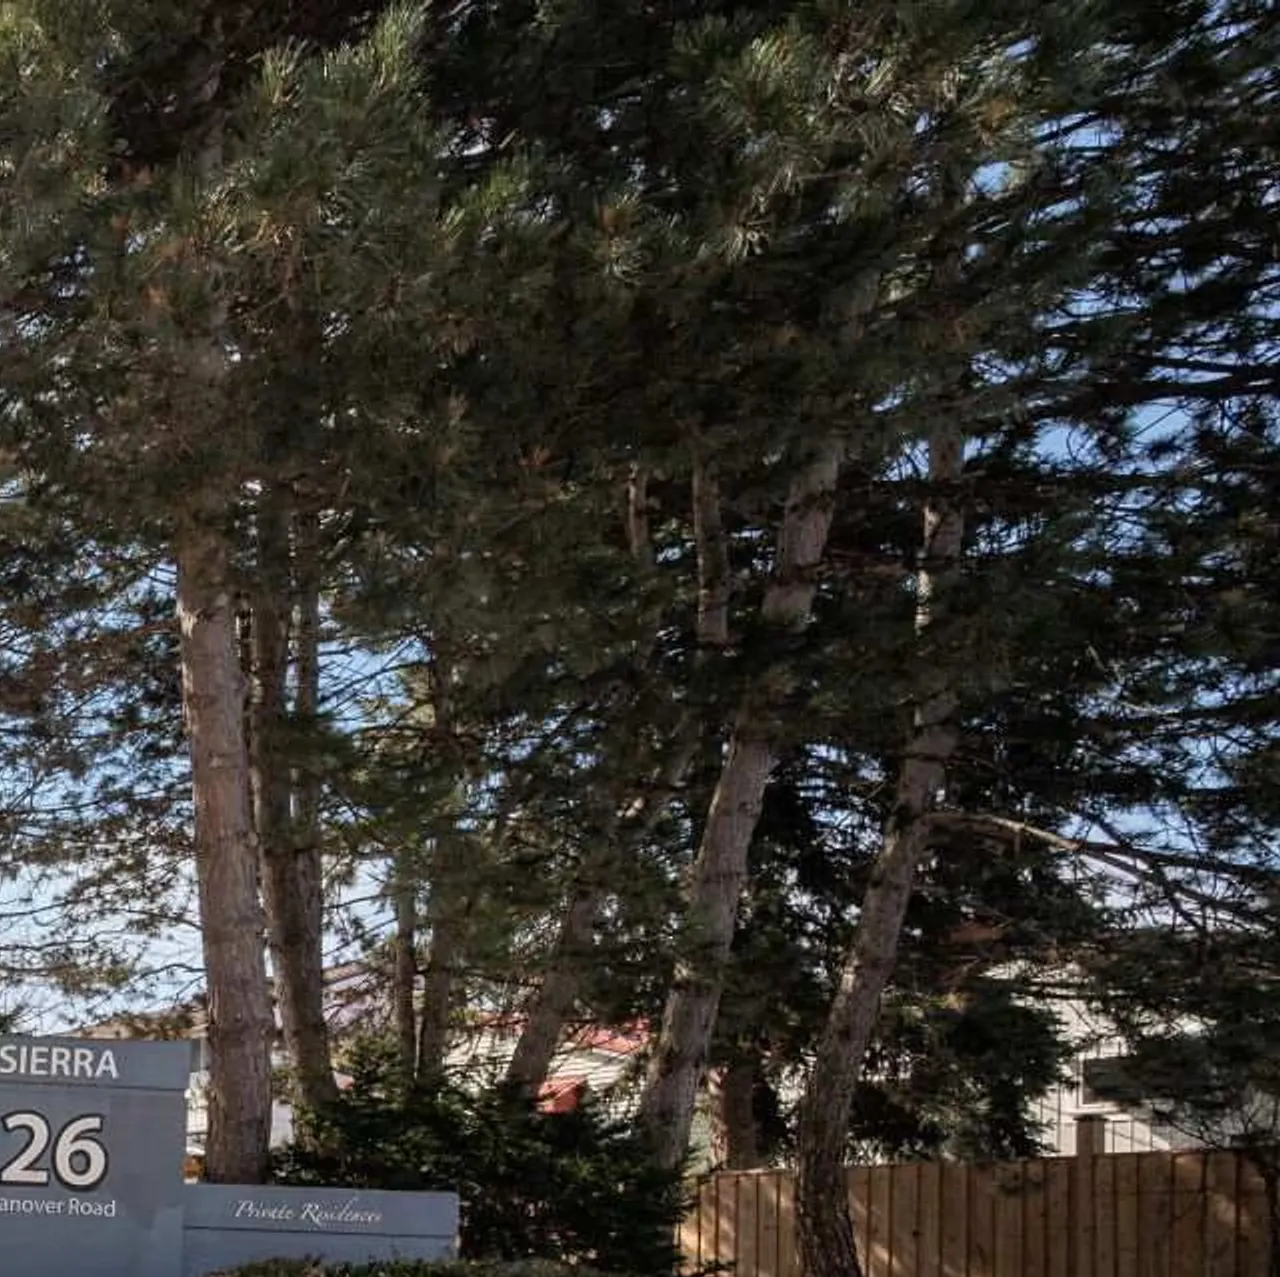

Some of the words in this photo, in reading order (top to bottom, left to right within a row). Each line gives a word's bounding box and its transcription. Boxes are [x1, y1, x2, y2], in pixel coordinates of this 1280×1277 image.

[0, 1044, 119, 1079] SIERRA
[68, 1198, 116, 1217] Road
[234, 1199, 294, 1219] Private
